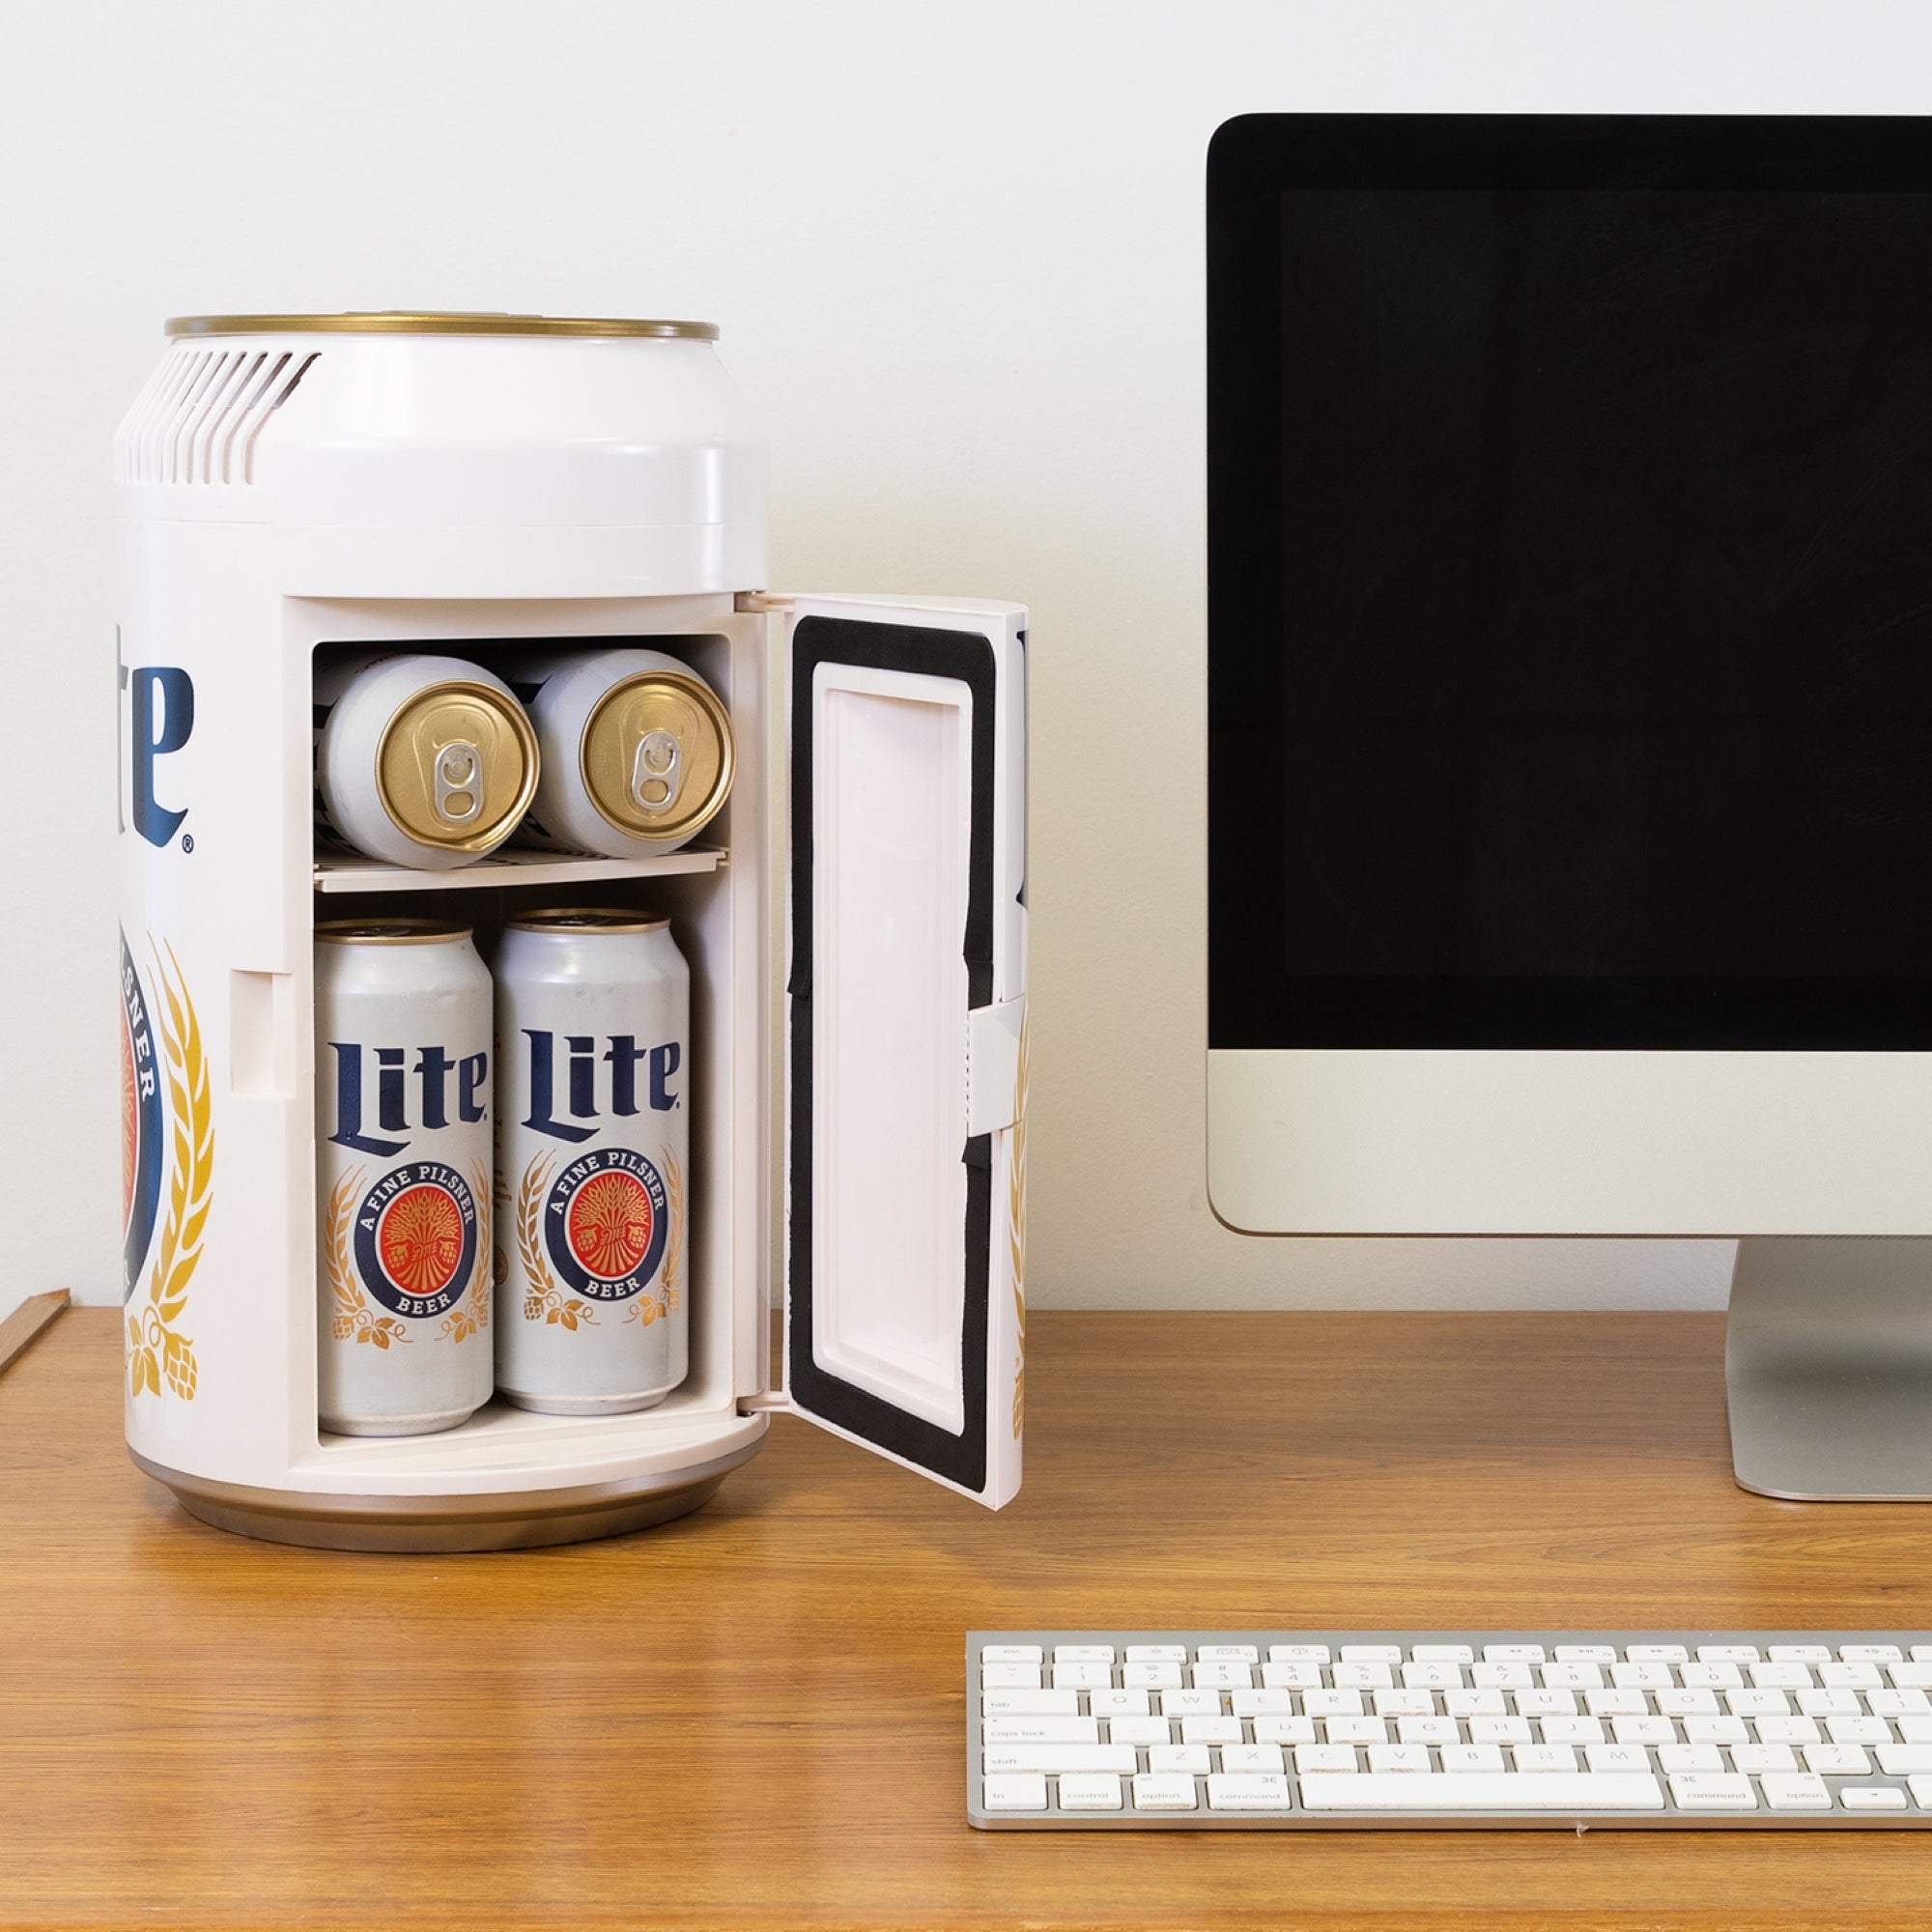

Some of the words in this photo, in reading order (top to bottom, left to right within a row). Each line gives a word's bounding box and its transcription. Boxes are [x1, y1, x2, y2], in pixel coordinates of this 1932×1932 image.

[327, 1041, 488, 1157] Lite
[521, 1029, 680, 1144] Lite
[366, 1170, 412, 1211] FINE
[418, 1165, 475, 1225] PILSNER
[556, 1155, 600, 1197] FINE
[607, 1151, 666, 1211] PILSNER
[360, 1217, 376, 1232] A
[551, 1201, 565, 1215] A
[396, 1293, 452, 1316] BEER
[584, 1276, 640, 1298] BEER
[1141, 1792, 1181, 1801] option
